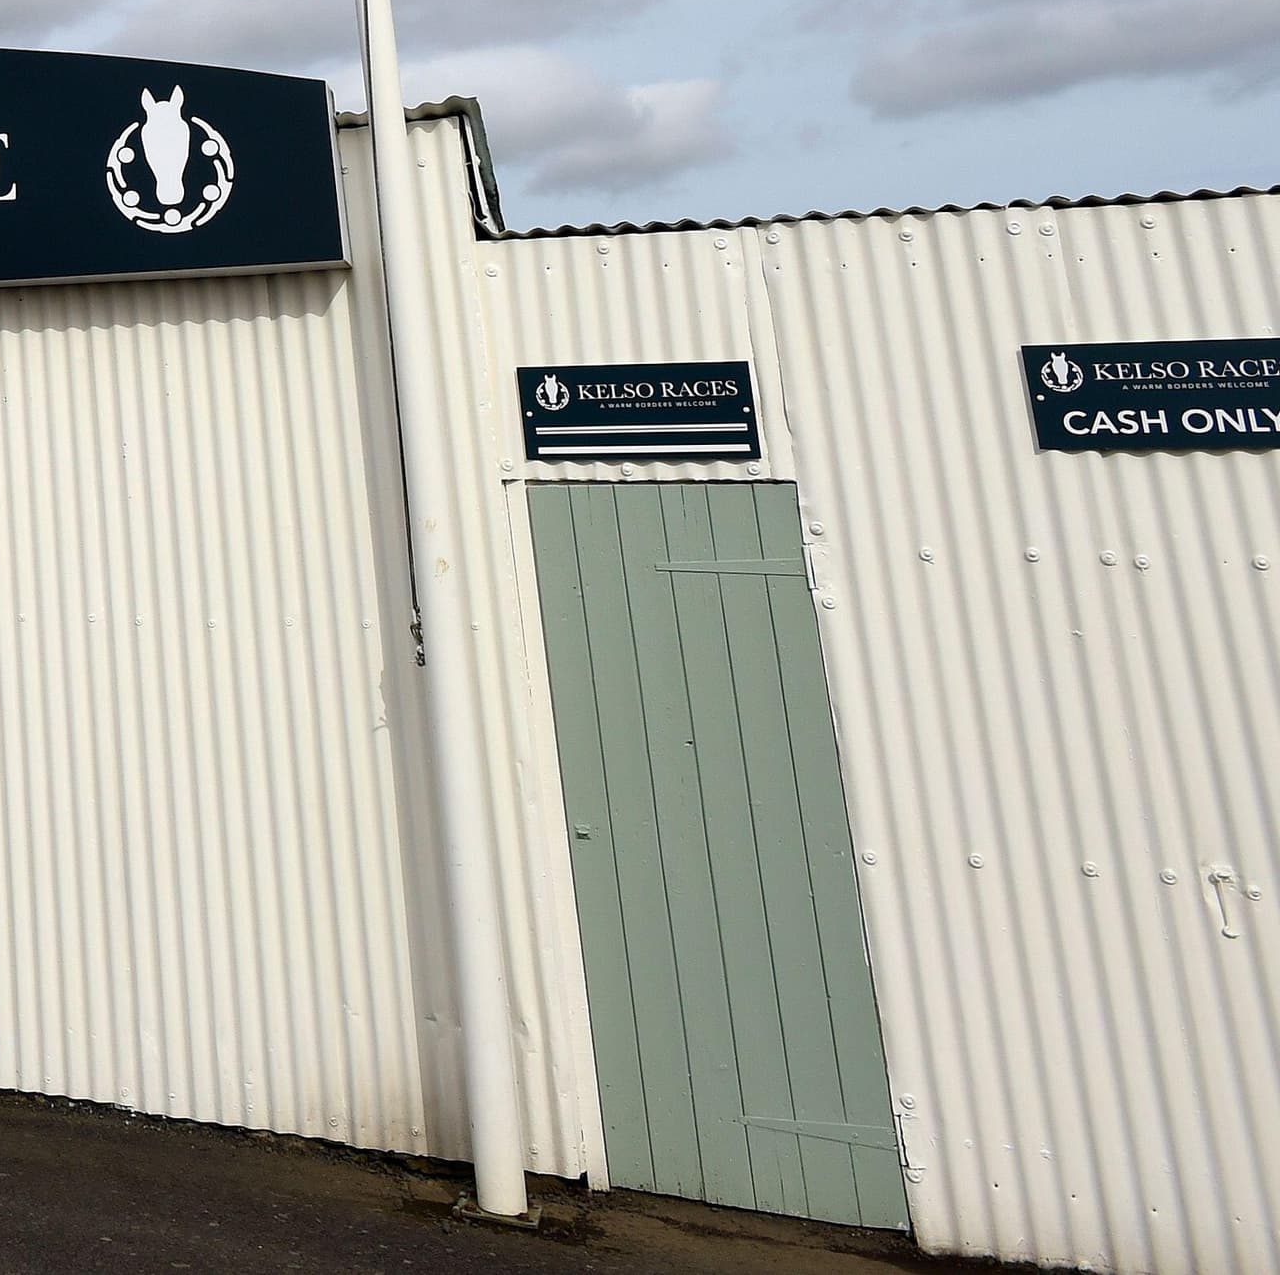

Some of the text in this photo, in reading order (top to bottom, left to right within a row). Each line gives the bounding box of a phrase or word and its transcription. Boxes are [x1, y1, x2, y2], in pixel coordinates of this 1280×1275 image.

[1092, 358, 1280, 381] KELSO RACE
[576, 380, 739, 401] KELSO RACES
[1167, 382, 1214, 390] BORDERS
[1217, 381, 1270, 389] WELCOME
[1063, 408, 1280, 435] CASH ONLY
